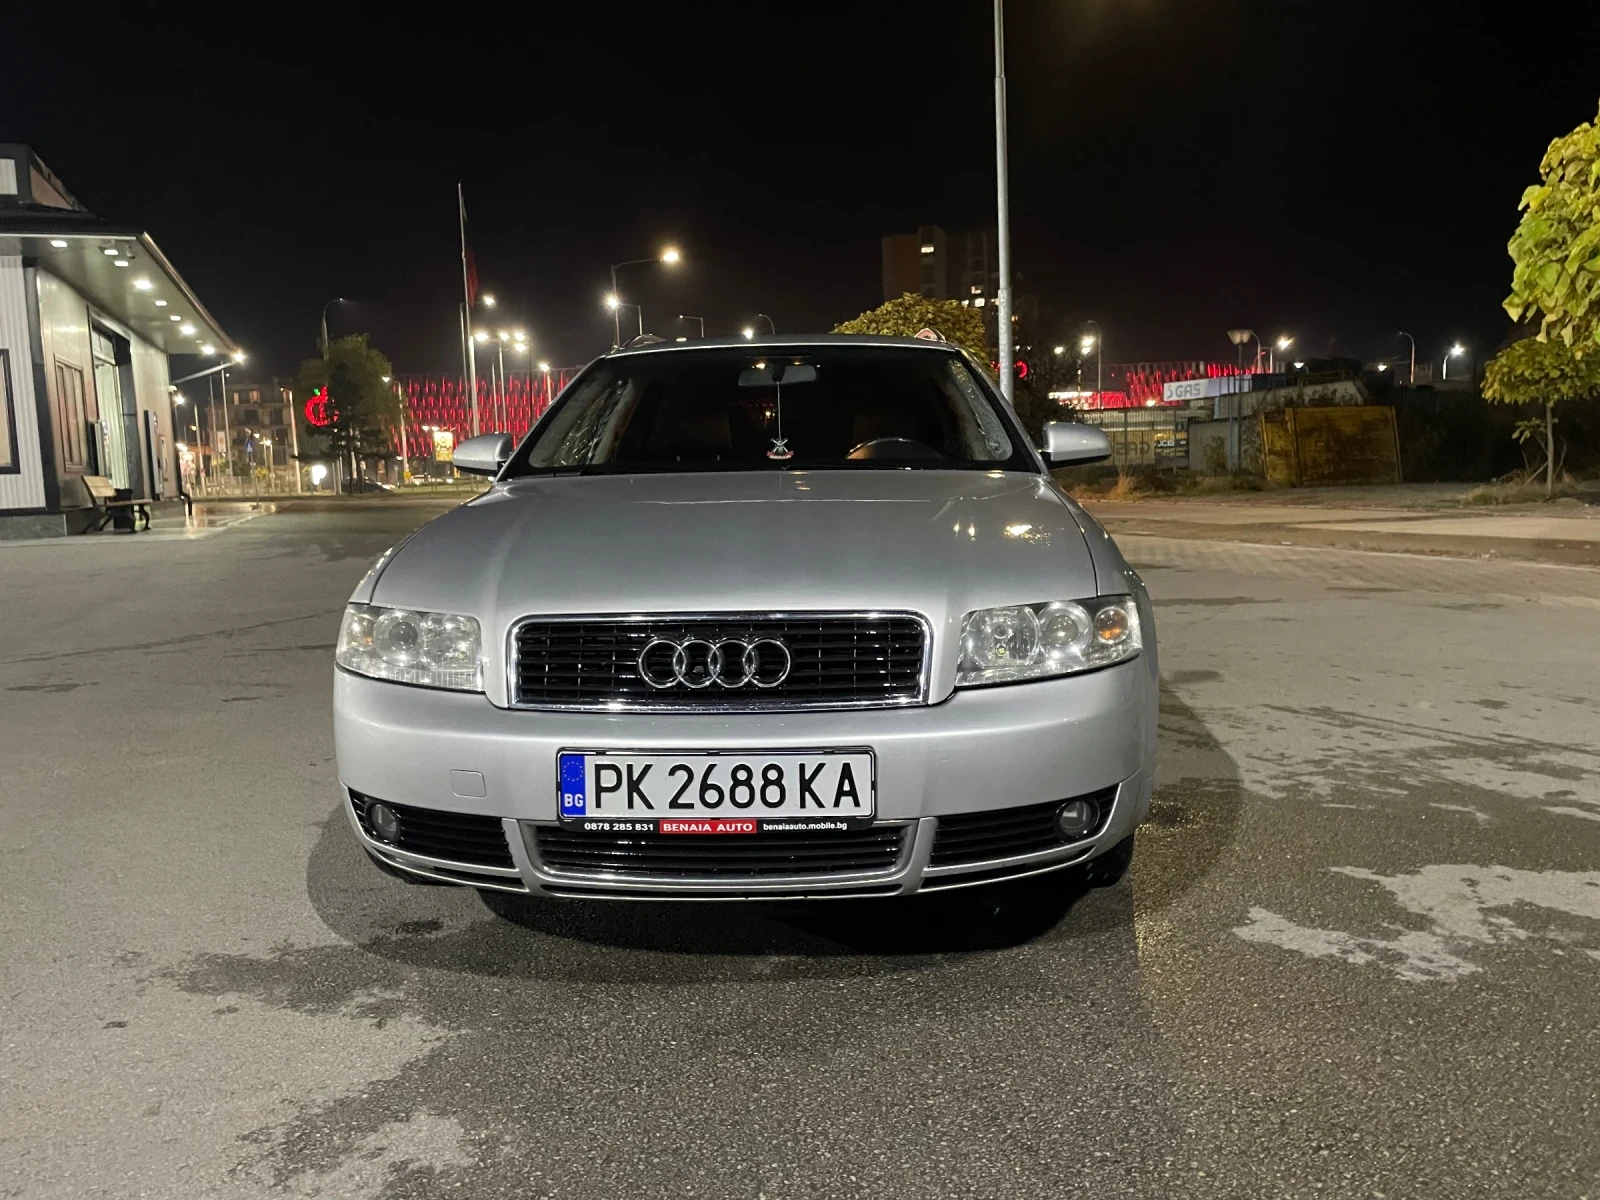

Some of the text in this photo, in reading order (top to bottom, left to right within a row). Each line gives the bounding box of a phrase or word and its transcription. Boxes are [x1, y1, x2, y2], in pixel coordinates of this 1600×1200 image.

[1175, 383, 1201, 398] GAS
[594, 762, 861, 810] PK 2688 KA
[564, 793, 584, 808] BG
[584, 822, 848, 832] 0878 285 831 BENAIA AUTO benaiaauto.mobile.bg
